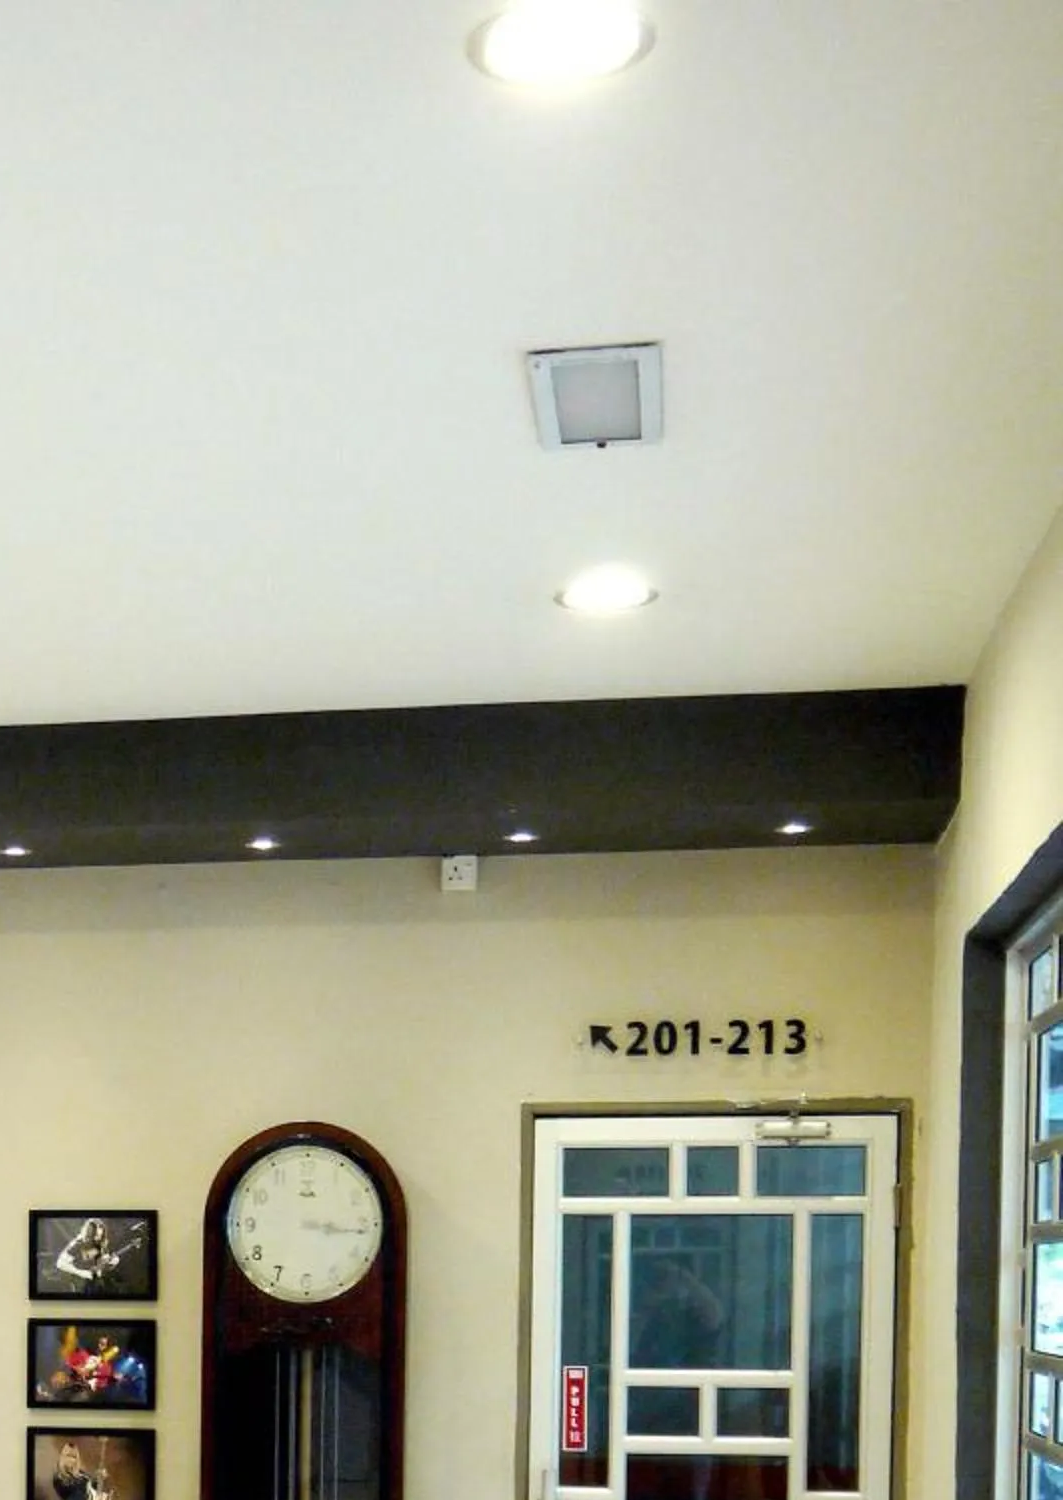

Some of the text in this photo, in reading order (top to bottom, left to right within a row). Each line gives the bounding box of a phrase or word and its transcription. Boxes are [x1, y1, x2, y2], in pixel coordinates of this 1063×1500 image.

[625, 1018, 807, 1057] 201-213
[244, 1216, 257, 1233] 9
[251, 1244, 263, 1261] 8
[272, 1264, 285, 1282] 7
[570, 1385, 580, 1428] PULL
